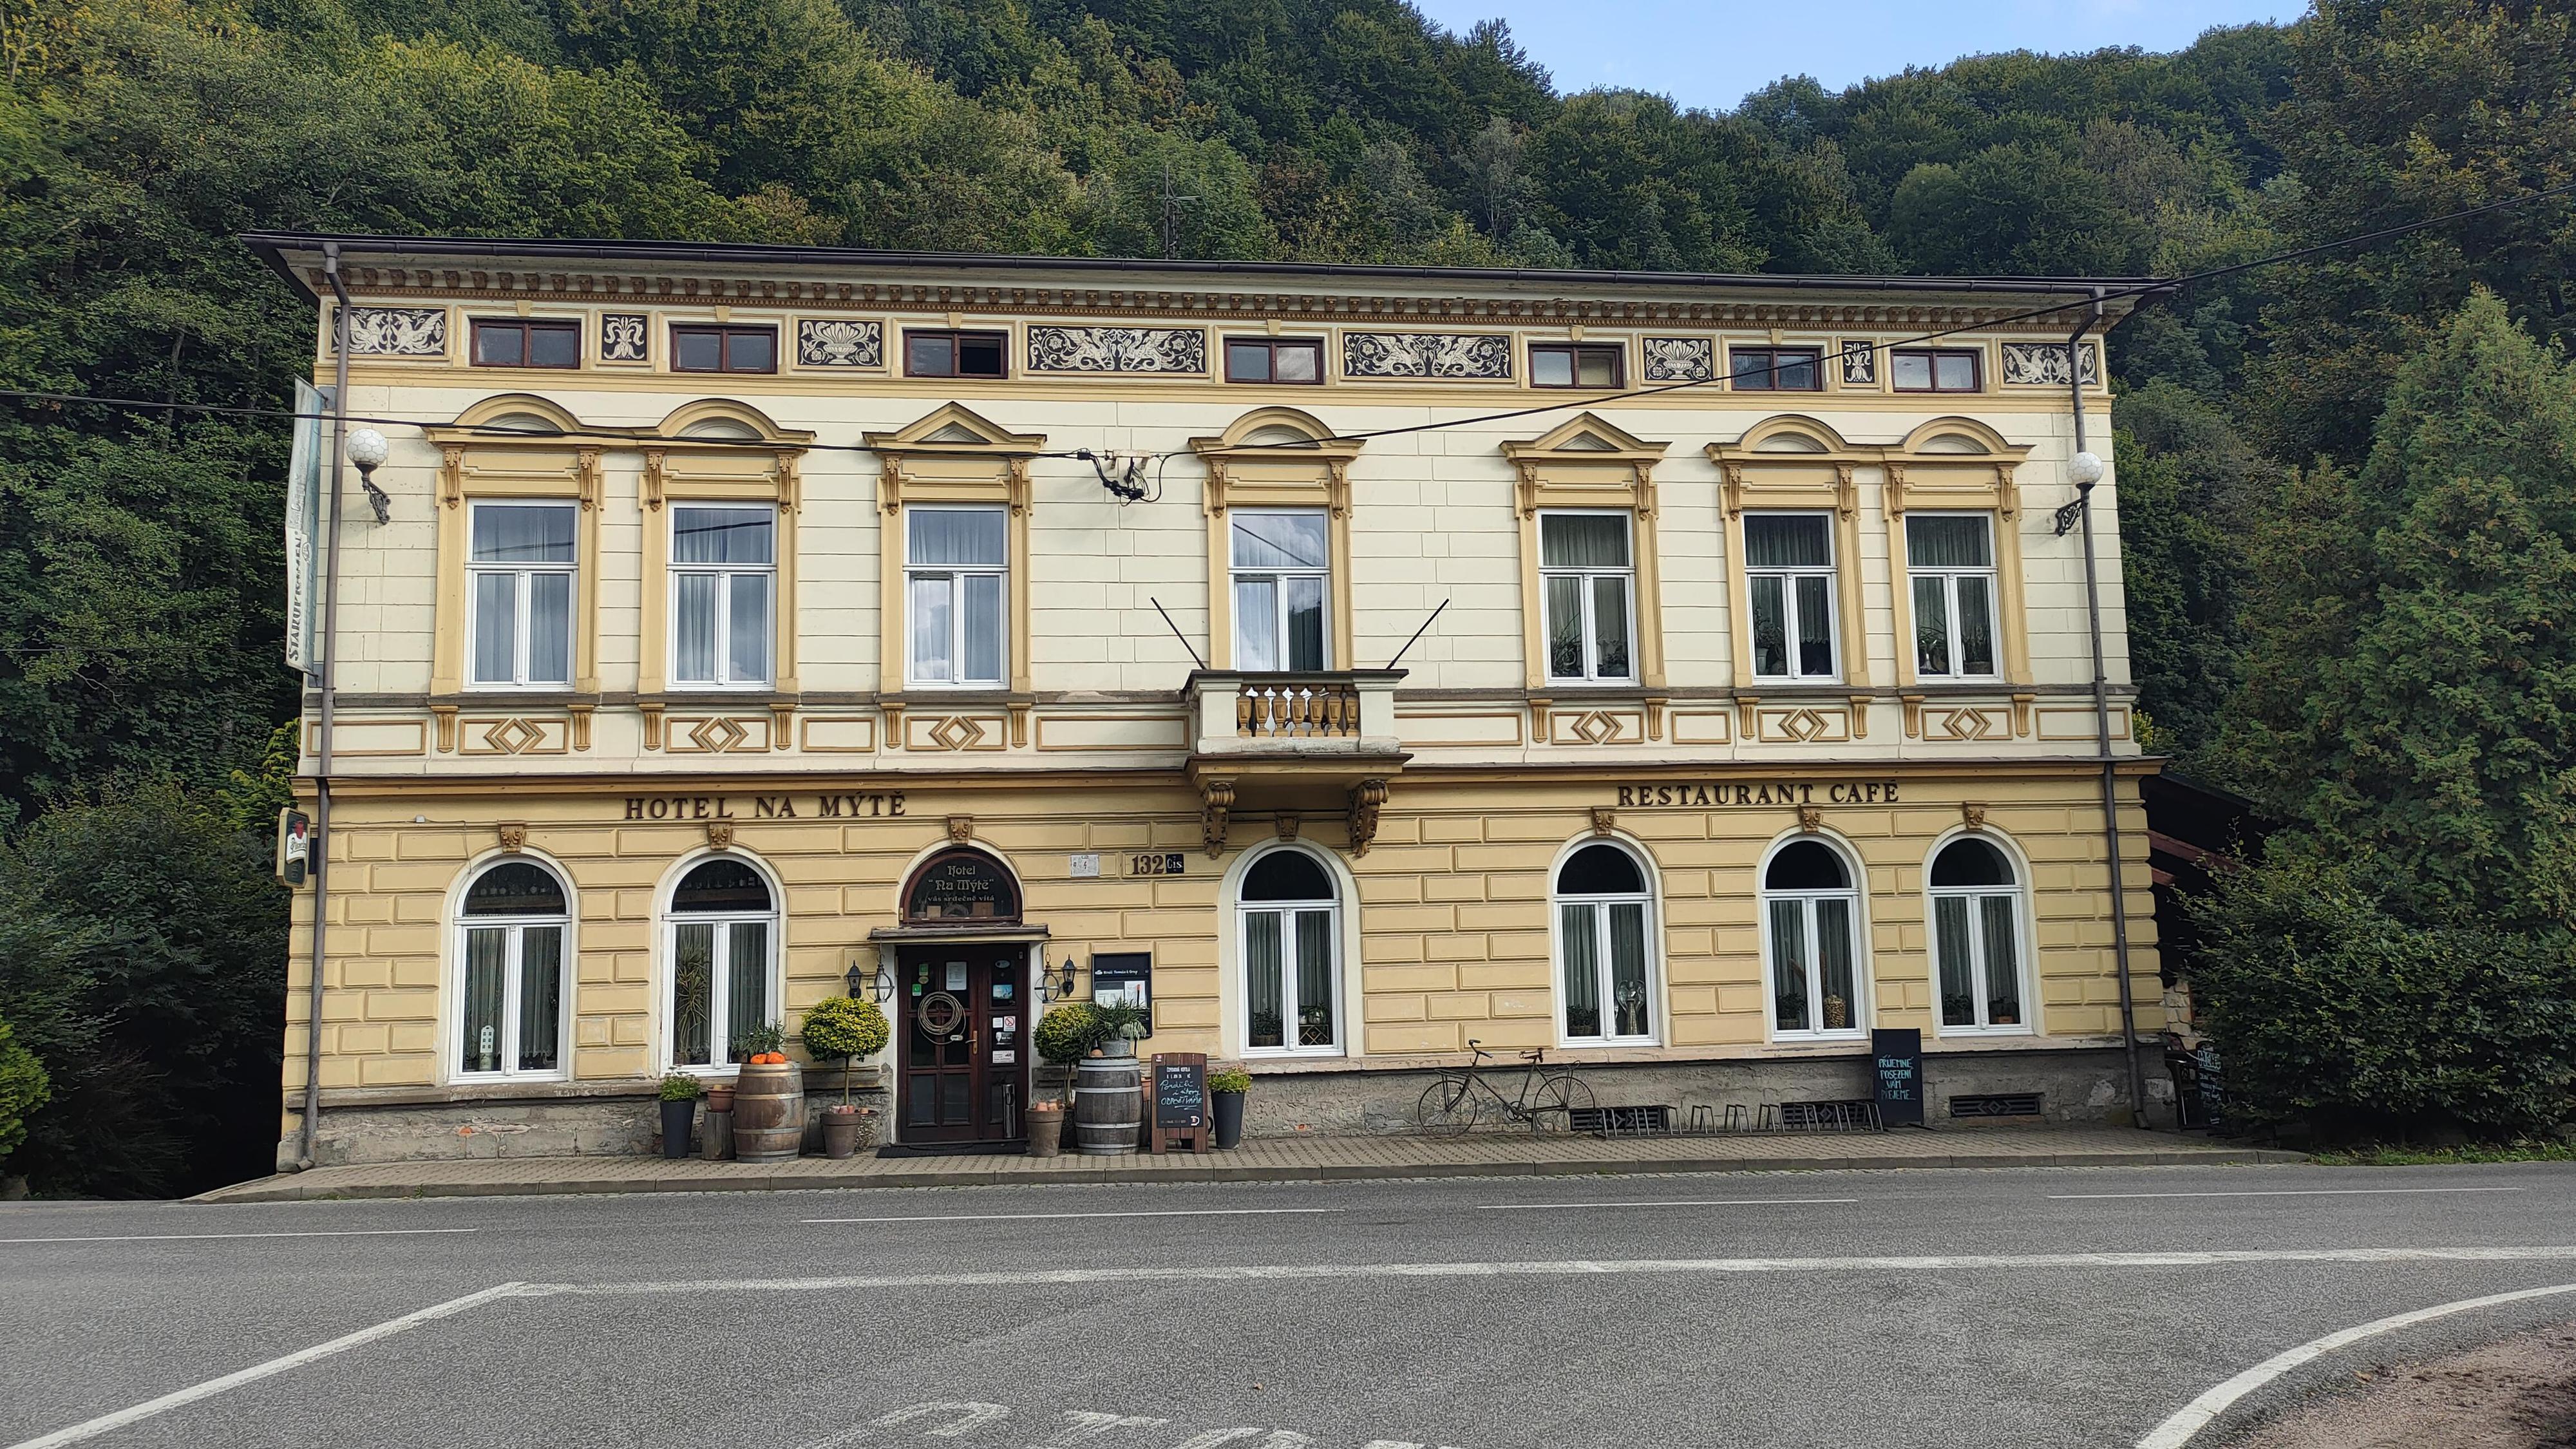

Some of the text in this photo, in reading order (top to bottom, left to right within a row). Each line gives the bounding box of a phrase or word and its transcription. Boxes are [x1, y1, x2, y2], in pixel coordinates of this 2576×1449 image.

[1617, 779, 1899, 806] RESTAURANT CAFÉ
[624, 790, 907, 819] HOTEL NA MÝTĚ
[947, 865, 976, 876] Hotel
[1132, 855, 1164, 875] 132
